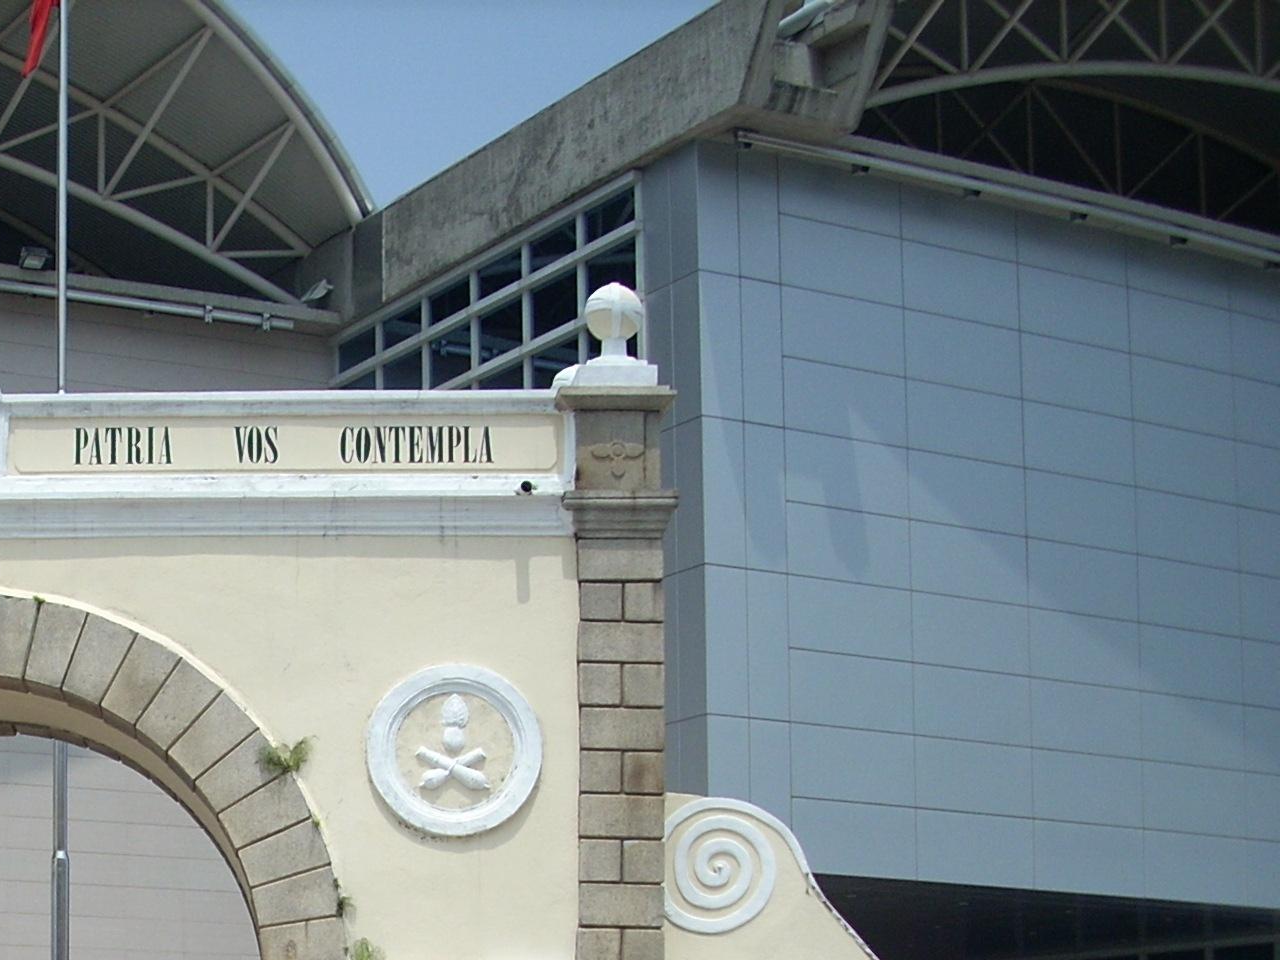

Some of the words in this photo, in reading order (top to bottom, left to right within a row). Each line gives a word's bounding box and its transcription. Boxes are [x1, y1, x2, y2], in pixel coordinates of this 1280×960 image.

[73, 427, 173, 465] PATRIA
[234, 426, 279, 465] VOS
[339, 426, 495, 464] CONTEMPLA
